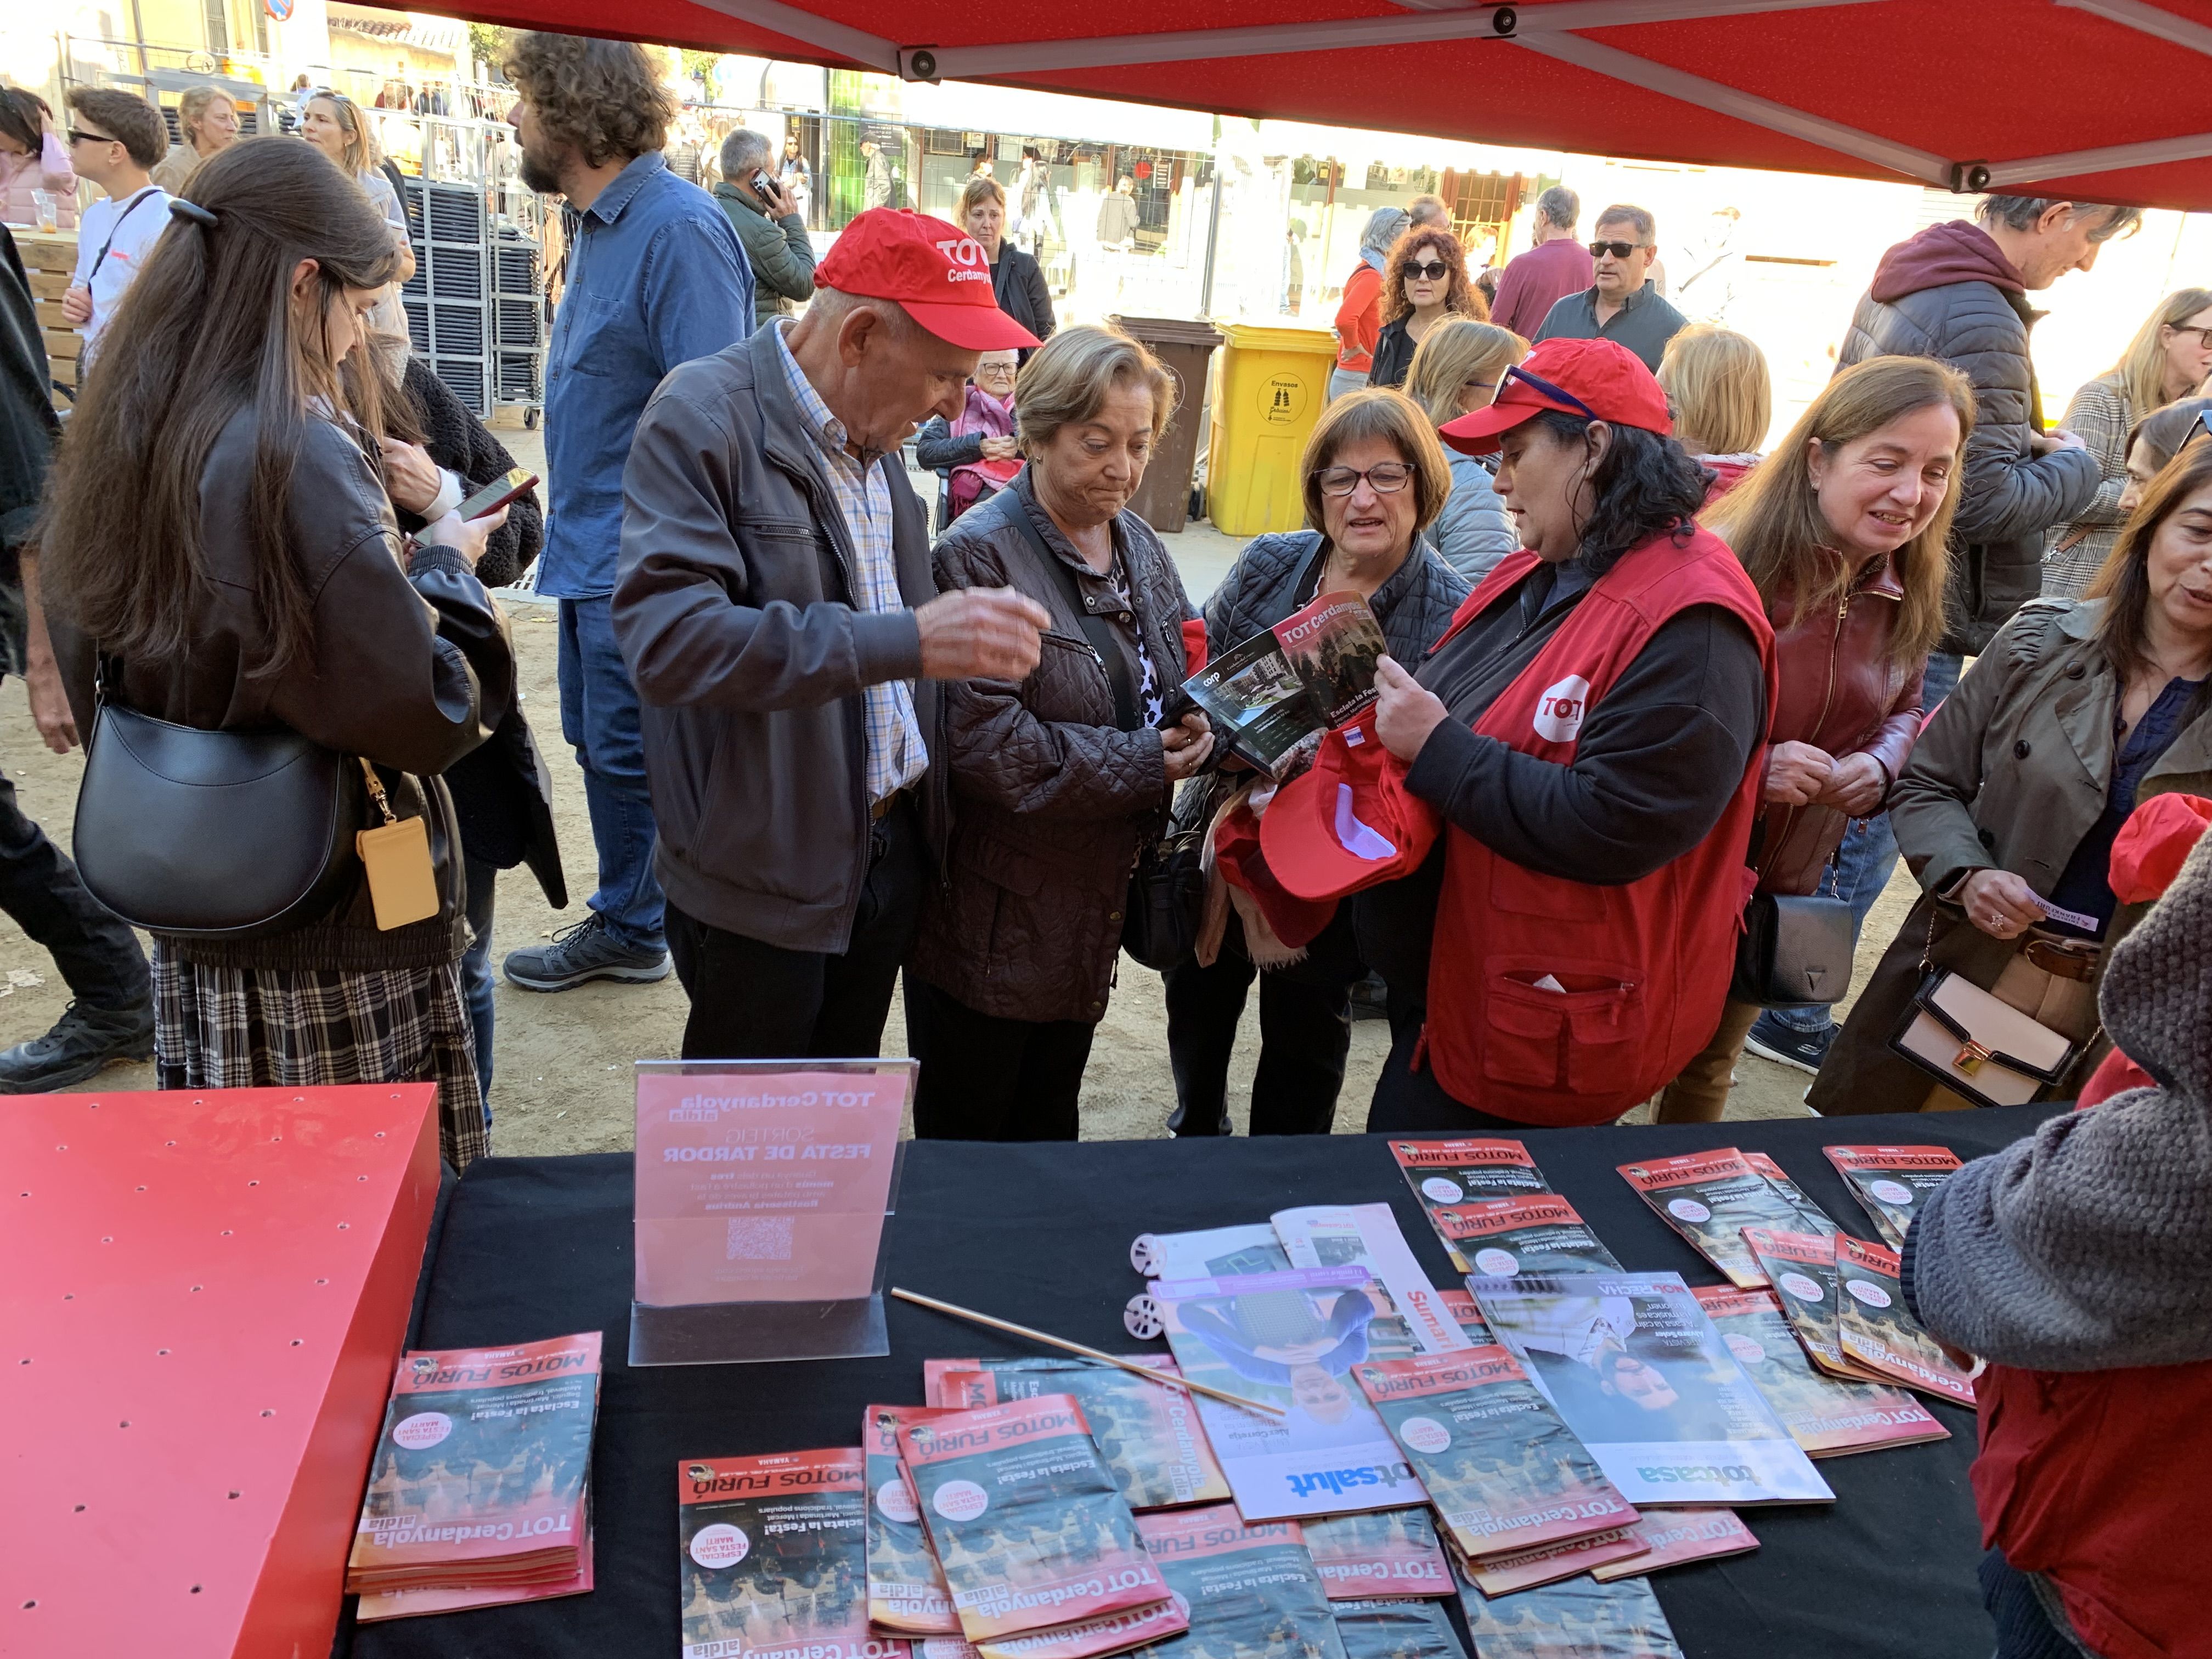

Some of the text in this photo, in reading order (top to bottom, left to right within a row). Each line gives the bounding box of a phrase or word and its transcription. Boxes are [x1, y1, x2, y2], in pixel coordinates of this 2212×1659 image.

[948, 269, 991, 284] Cerdany
[1282, 620, 1314, 644] TOT
[1203, 672, 1220, 687] corp
[1330, 686, 1378, 718] Esclata la Fest
[1544, 697, 1582, 720] TOT
[1407, 1151, 1523, 1164] MOTOS FURIÓ
[1847, 1156, 1957, 1167] MOTOS FURIÓ
[1692, 1162, 1746, 1176] MOTOS
[1468, 1179, 1495, 1187] Festa!
[1641, 1171, 1692, 1187] FURIÓ
[1708, 1194, 1735, 1204] Festa!
[1510, 1209, 1569, 1223] MOTOS
[1453, 1216, 1508, 1235] FURIÓ
[1521, 1244, 1551, 1254] Festa!
[1764, 1244, 1818, 1259] FURIÓ
[1407, 1290, 1460, 1348] Sumari
[1663, 1319, 1685, 1328] casa,
[484, 1350, 515, 1359] YAMAHA
[1414, 1358, 1441, 1368] YAMAHA
[500, 1354, 586, 1379] MOTOS
[1442, 1362, 1511, 1383] MOTOS
[1857, 1344, 1963, 1392] Cerdanyola
[413, 1368, 491, 1389] FURIÓ
[1375, 1376, 1437, 1398] FURIÓ
[471, 1401, 579, 1421] Esclata la Festa!
[971, 1410, 1001, 1421] YAMAHA
[1453, 1403, 1540, 1424] Esclata la Festa!
[422, 1426, 449, 1435] FESTA
[997, 1414, 1076, 1438] MOTOS
[1797, 1409, 1931, 1436] TOT Cerdanyola
[402, 1433, 442, 1442] ESPECIAL
[1161, 1381, 1207, 1489] OT Cerdanyola
[919, 1433, 990, 1460] FURIÓ
[758, 1457, 789, 1466] YAMAHA
[997, 1460, 1096, 1485] Esclata la Festa!
[1170, 1465, 1188, 1497] aldia
[1285, 1462, 1417, 1498] otsalut
[1636, 1465, 1762, 1487] totcasa
[693, 1469, 862, 1499] MOTOS FURIÓ
[758, 1505, 792, 1514] populars
[939, 1494, 985, 1510] FESTA SANT
[946, 1502, 985, 1514] ESPECIAL
[368, 1516, 414, 1530] aldia
[1452, 1510, 1489, 1525] aldia
[1466, 1499, 1623, 1538] TOT Cerdanyola
[374, 1515, 571, 1549] TOT Cerdanyola
[764, 1519, 864, 1535] sclata la Festa!
[1204, 1522, 1288, 1547] MOTOS
[1699, 1518, 1742, 1540] TOT
[696, 1546, 719, 1554] SANT
[1148, 1536, 1195, 1554] FUR
[701, 1551, 741, 1560] ESPECIAL
[1317, 1561, 1441, 1582] TOT Cerda
[879, 1585, 921, 1599] aldia
[1200, 1572, 1307, 1596] Esclata la Festa!
[964, 1585, 1007, 1602] aldia
[977, 1567, 1157, 1620] TOT Cerdanyola
[889, 1597, 957, 1616] nyola
[1330, 1601, 1361, 1611] Fest
[693, 1641, 738, 1657] aldia
[847, 1639, 901, 1659] TOT
